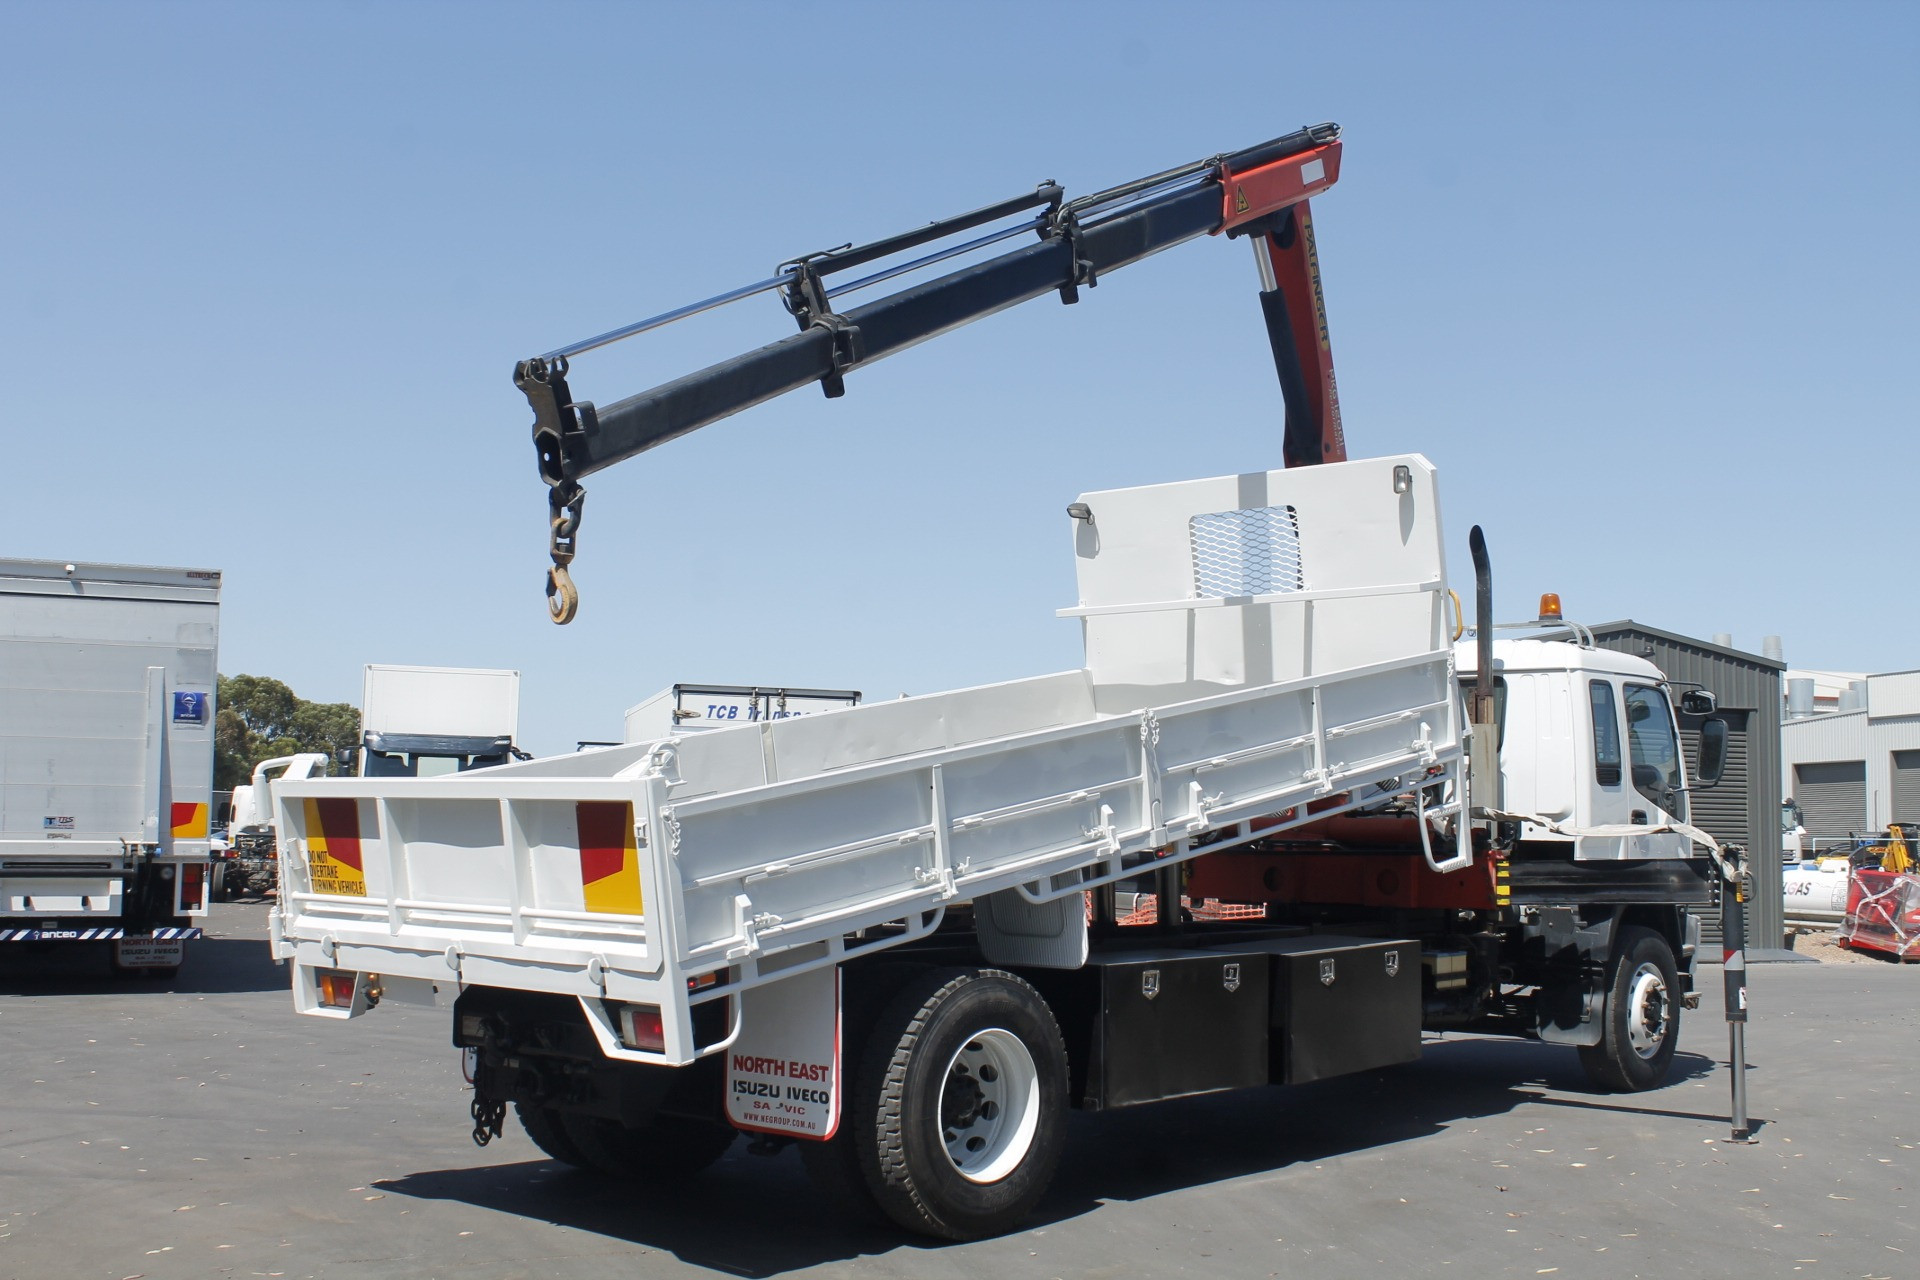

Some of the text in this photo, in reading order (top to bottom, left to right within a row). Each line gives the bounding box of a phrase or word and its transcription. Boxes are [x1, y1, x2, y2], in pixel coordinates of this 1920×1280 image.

[1304, 222, 1329, 342] PALFINGER
[707, 704, 739, 719] TCB
[308, 850, 328, 864] DO NOT
[309, 864, 339, 879] OVERTAKE
[311, 878, 364, 894] TURNING VEHICLE
[41, 930, 77, 938] anteo
[733, 1055, 830, 1082] NORTH EAST
[733, 1080, 830, 1105] ISUZU IVECO
[753, 1101, 771, 1110] SA
[784, 1105, 805, 1115] VIC
[743, 1112, 816, 1130] WWW.NEGROUP.COM.AU
